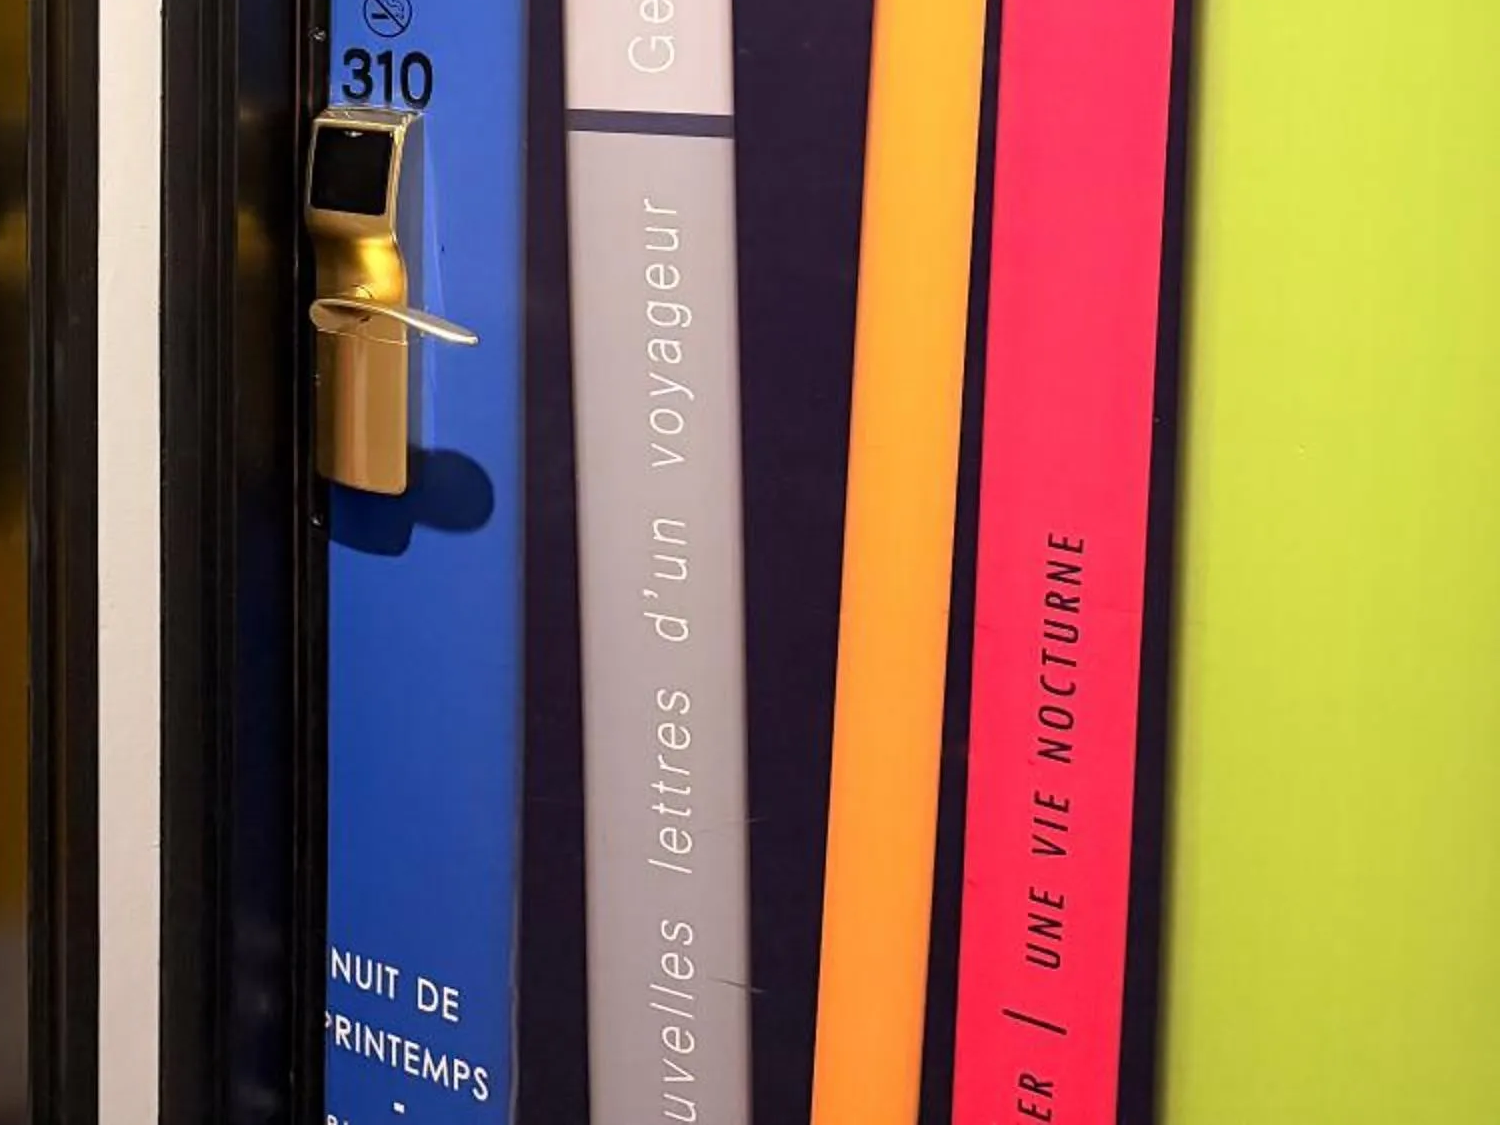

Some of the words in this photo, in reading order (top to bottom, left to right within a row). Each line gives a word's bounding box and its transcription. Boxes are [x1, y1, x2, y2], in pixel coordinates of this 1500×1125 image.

[342, 48, 433, 110] 310
[643, 198, 696, 468] voyageur
[1036, 533, 1084, 765] NOCTURNE
[647, 688, 693, 874] lettres
[1031, 791, 1070, 856] VIE
[1025, 887, 1064, 970] UNE
[331, 946, 399, 1000] NUIT
[417, 976, 460, 1023] DE
